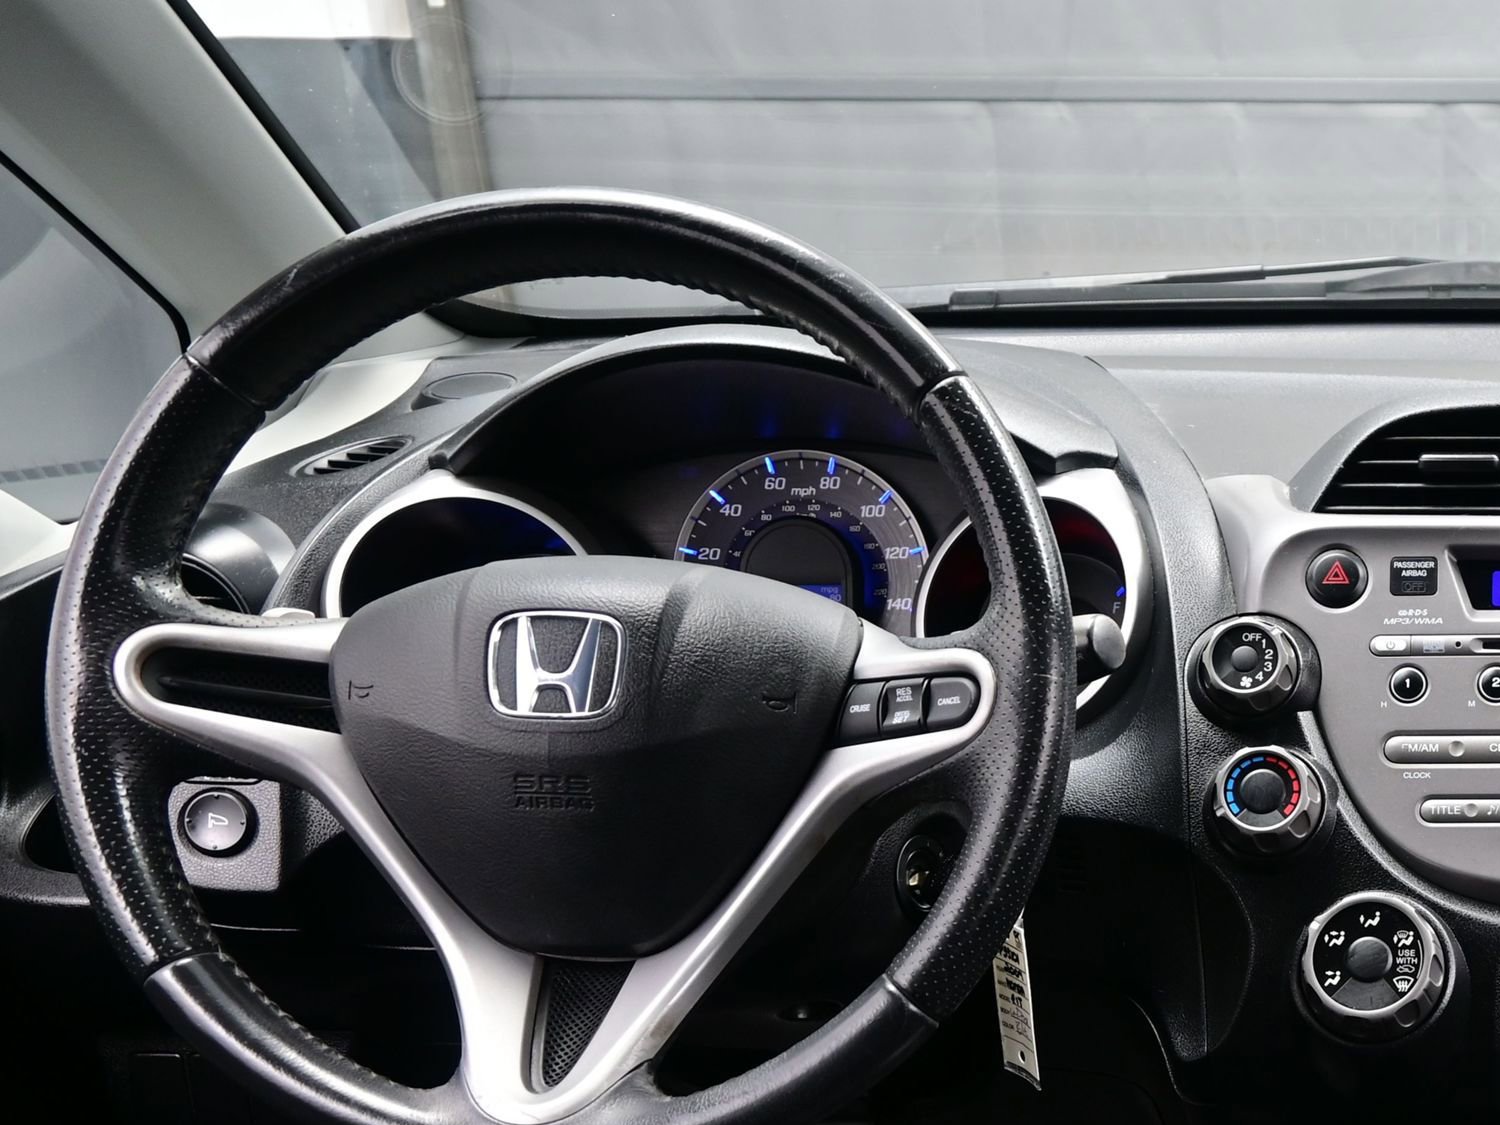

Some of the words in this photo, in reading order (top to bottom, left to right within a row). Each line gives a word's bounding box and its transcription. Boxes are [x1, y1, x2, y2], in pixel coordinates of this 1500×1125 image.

[765, 477, 786, 490] 60
[820, 477, 840, 490] 80
[791, 486, 816, 497] mph
[720, 504, 742, 517] 40
[860, 504, 885, 518] 100
[698, 548, 720, 560] 20
[884, 547, 909, 559] 120
[1394, 561, 1435, 569] PASSENGER
[887, 598, 911, 610] 140
[1112, 602, 1121, 614] F
[1242, 633, 1262, 641] OFF
[1262, 639, 1266, 648] 1
[1264, 649, 1273, 659] 2
[1264, 662, 1272, 671] 3
[1255, 671, 1264, 681] 4
[1405, 678, 1410, 688] 1
[1491, 677, 1500, 688] 2
[896, 687, 912, 696] RES
[937, 696, 960, 706] CANCEL
[850, 704, 871, 713] CRUISE
[514, 775, 592, 793] SRS
[514, 796, 595, 811] AIRBAG
[1430, 806, 1461, 815] TITLE
